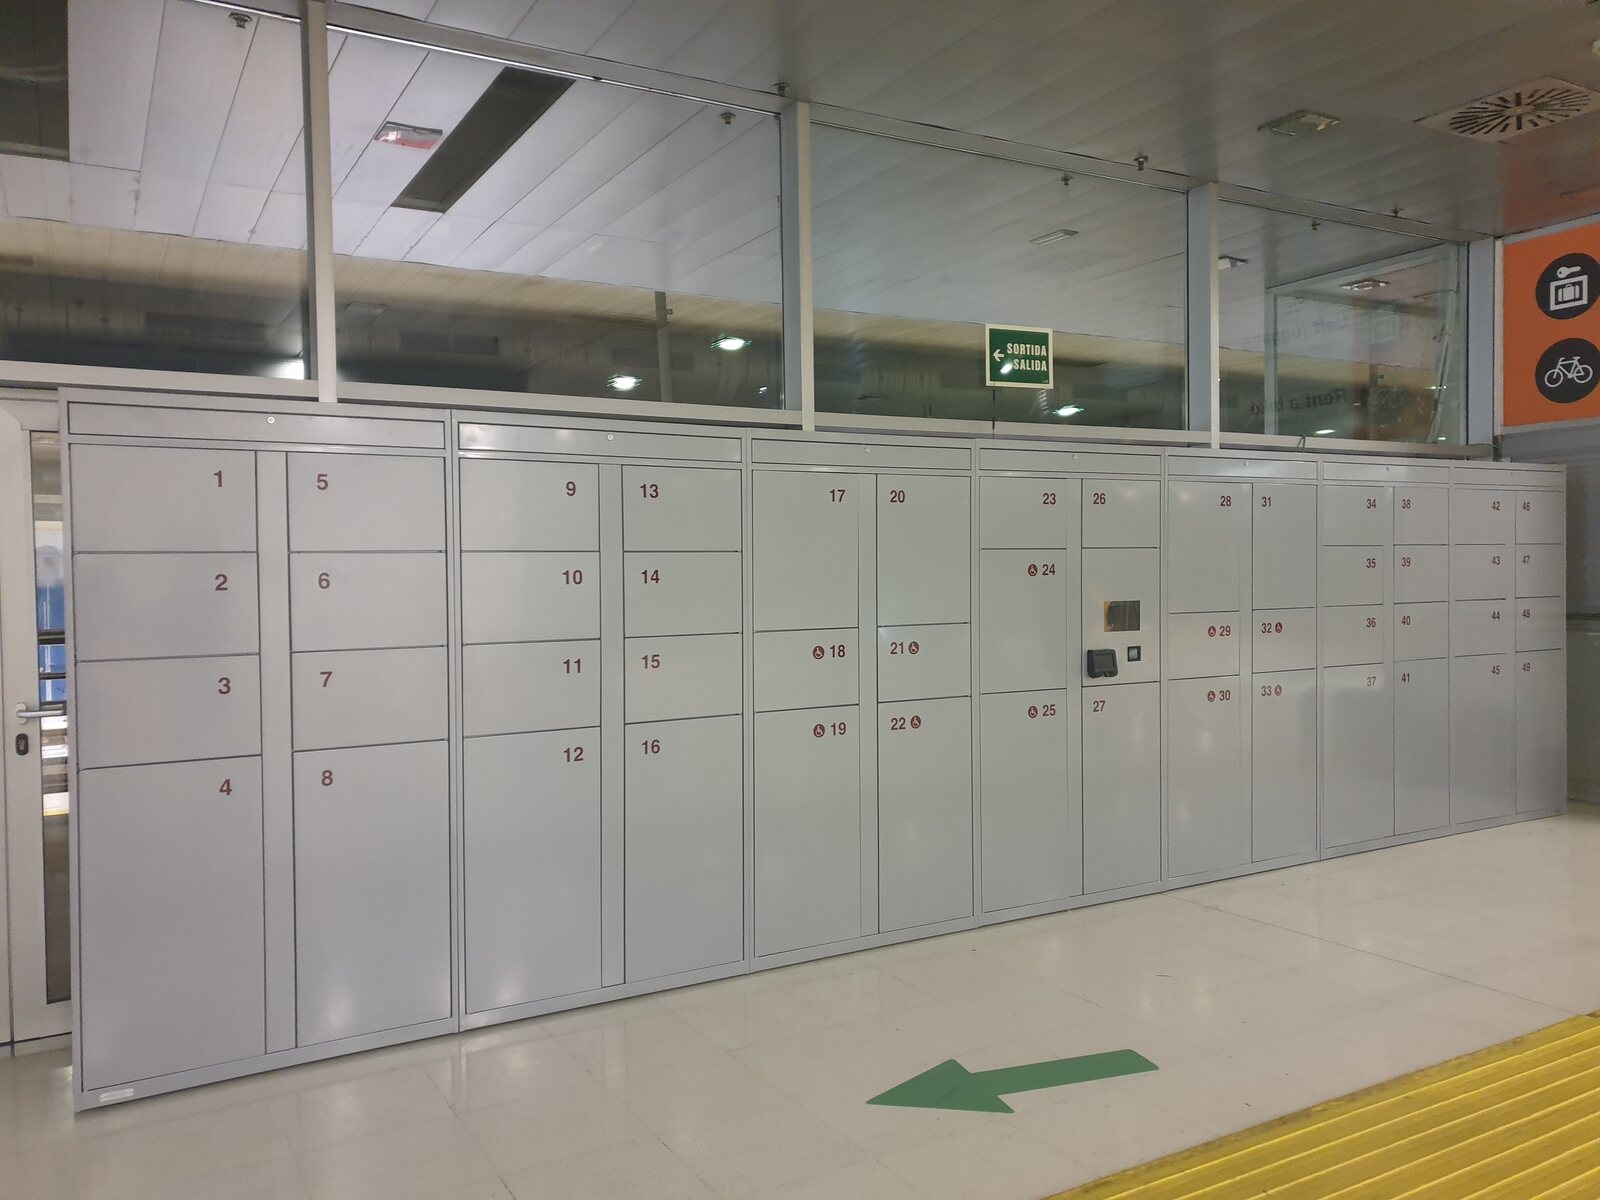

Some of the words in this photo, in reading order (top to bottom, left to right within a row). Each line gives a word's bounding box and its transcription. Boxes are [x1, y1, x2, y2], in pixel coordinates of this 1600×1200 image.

[1006, 343, 1047, 357] SORTIDA
[1013, 359, 1047, 371] SALIDA
[212, 470, 222, 487] 1
[316, 473, 328, 490] 5
[565, 481, 576, 496] 9
[639, 484, 658, 498] 13
[829, 489, 845, 502] 17
[889, 490, 905, 503] 20
[1042, 493, 1056, 505] 23
[1093, 493, 1105, 505] 26
[1221, 496, 1231, 506] 28
[1262, 497, 1271, 507] 31
[1367, 499, 1376, 509] 34
[1402, 499, 1410, 509] 38
[1492, 501, 1500, 510] 42
[1522, 502, 1530, 511] 46
[1367, 559, 1376, 568] 35
[1402, 557, 1411, 567] 39
[1492, 556, 1500, 565] 43
[1522, 555, 1530, 564] 47
[1041, 564, 1055, 575] 24
[214, 573, 227, 591] 2
[318, 572, 330, 589] 6
[562, 570, 582, 584] 10
[641, 570, 660, 584] 14
[1492, 611, 1500, 619] 44
[1522, 609, 1530, 618] 48
[1367, 618, 1376, 627] 36
[1402, 616, 1410, 625] 40
[1219, 626, 1230, 636] 29
[1262, 623, 1272, 633] 32
[829, 645, 845, 657] 18
[890, 642, 905, 654] 21
[563, 659, 580, 673] 11
[641, 655, 660, 669] 15
[1523, 663, 1530, 672] 49
[1492, 666, 1500, 675] 45
[319, 670, 332, 687] 7
[1367, 677, 1376, 686] 37
[1402, 673, 1410, 682] 41
[217, 677, 230, 694] 3
[1262, 686, 1272, 696] 33
[1219, 690, 1230, 701] 30
[1041, 704, 1055, 716] 25
[1093, 700, 1105, 712] 27
[830, 722, 846, 735] 19
[890, 717, 906, 730] 22
[641, 740, 660, 754] 16
[563, 747, 583, 762] 12
[320, 769, 333, 786] 8
[218, 778, 232, 795] 4
